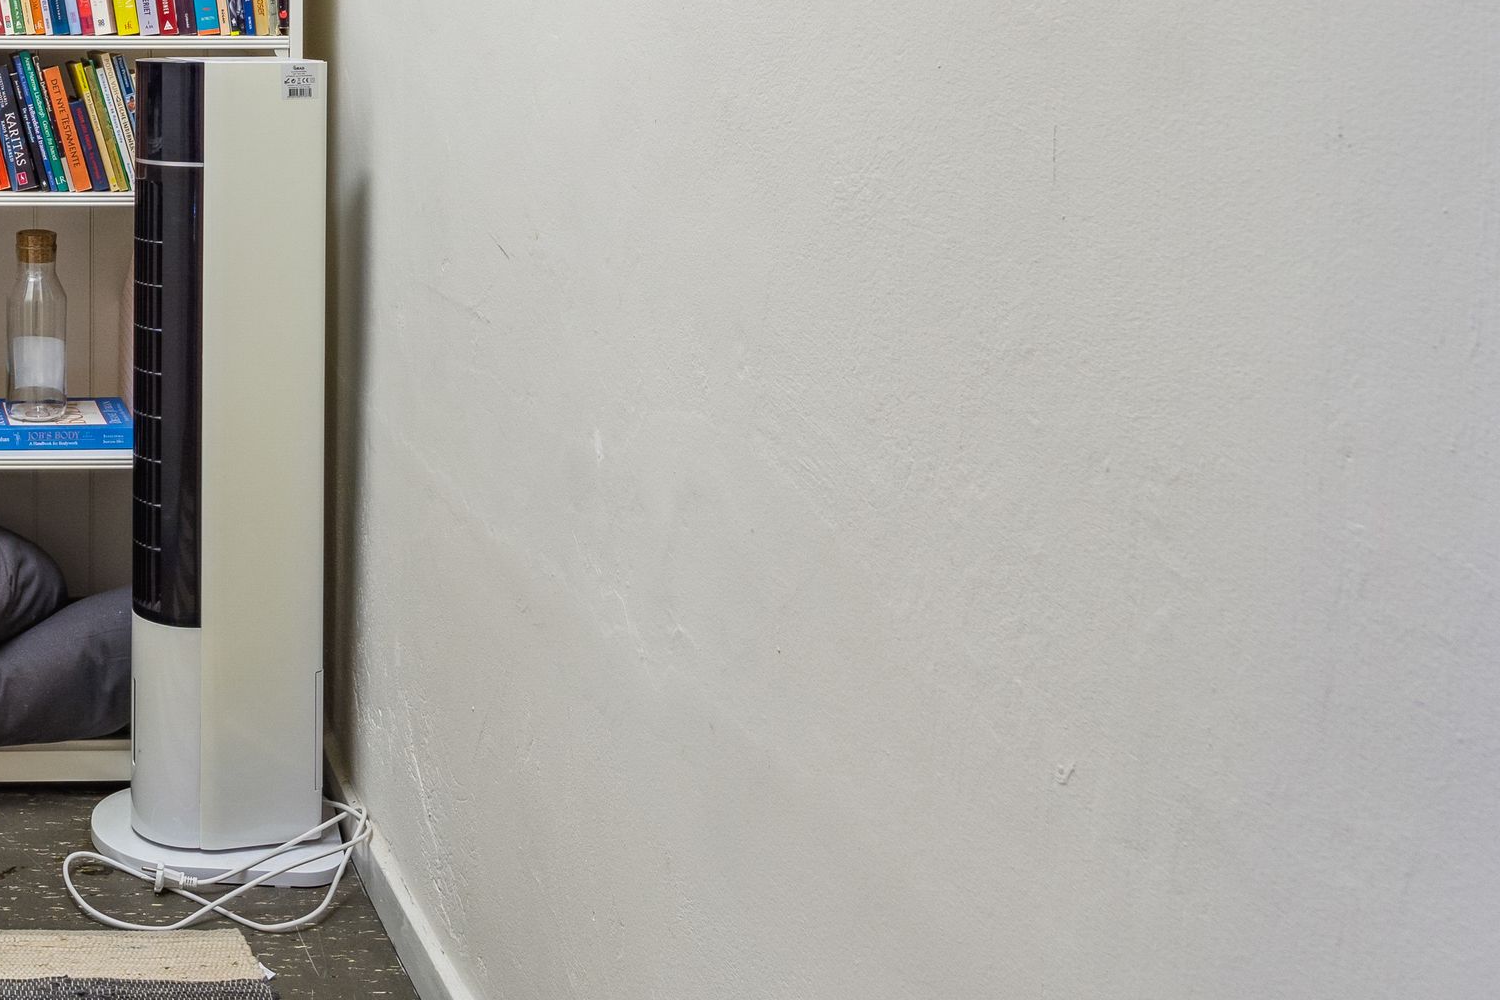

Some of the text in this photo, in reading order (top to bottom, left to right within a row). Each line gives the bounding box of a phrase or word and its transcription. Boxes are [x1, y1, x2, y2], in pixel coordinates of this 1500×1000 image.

[4, 112, 27, 167] KARITAS
[50, 78, 80, 168] DET NYE TESTAMENTE
[55, 431, 79, 440] BODY
